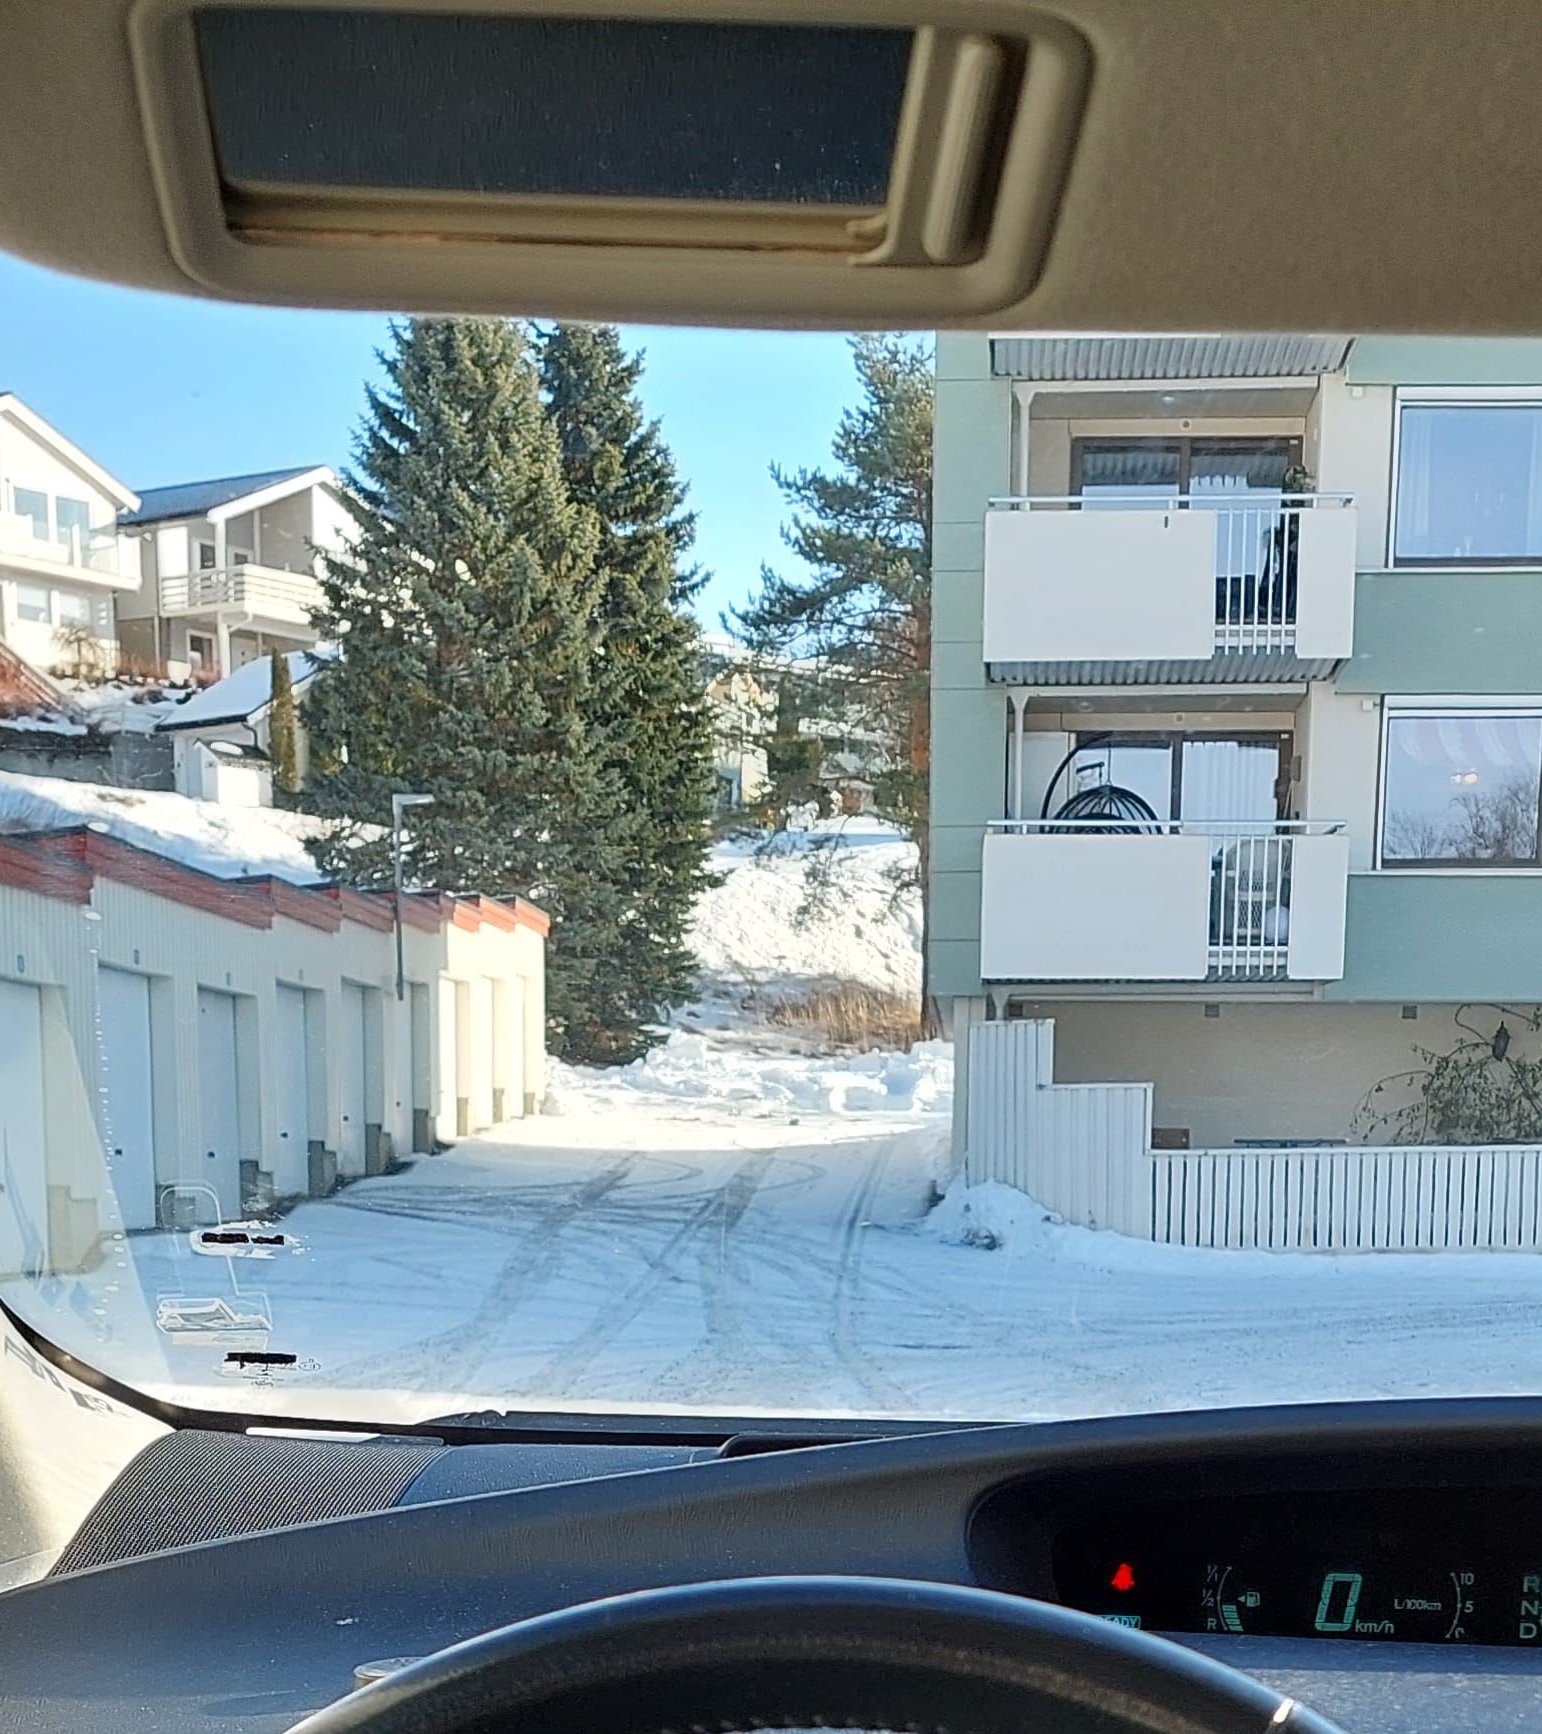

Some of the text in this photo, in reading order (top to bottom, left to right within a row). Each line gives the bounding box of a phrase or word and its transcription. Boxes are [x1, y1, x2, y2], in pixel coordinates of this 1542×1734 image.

[1314, 1573, 1363, 1632] 0
[1464, 1601, 1474, 1613] 5
[1521, 1600, 1539, 1615] N
[1519, 1622, 1537, 1638] D
